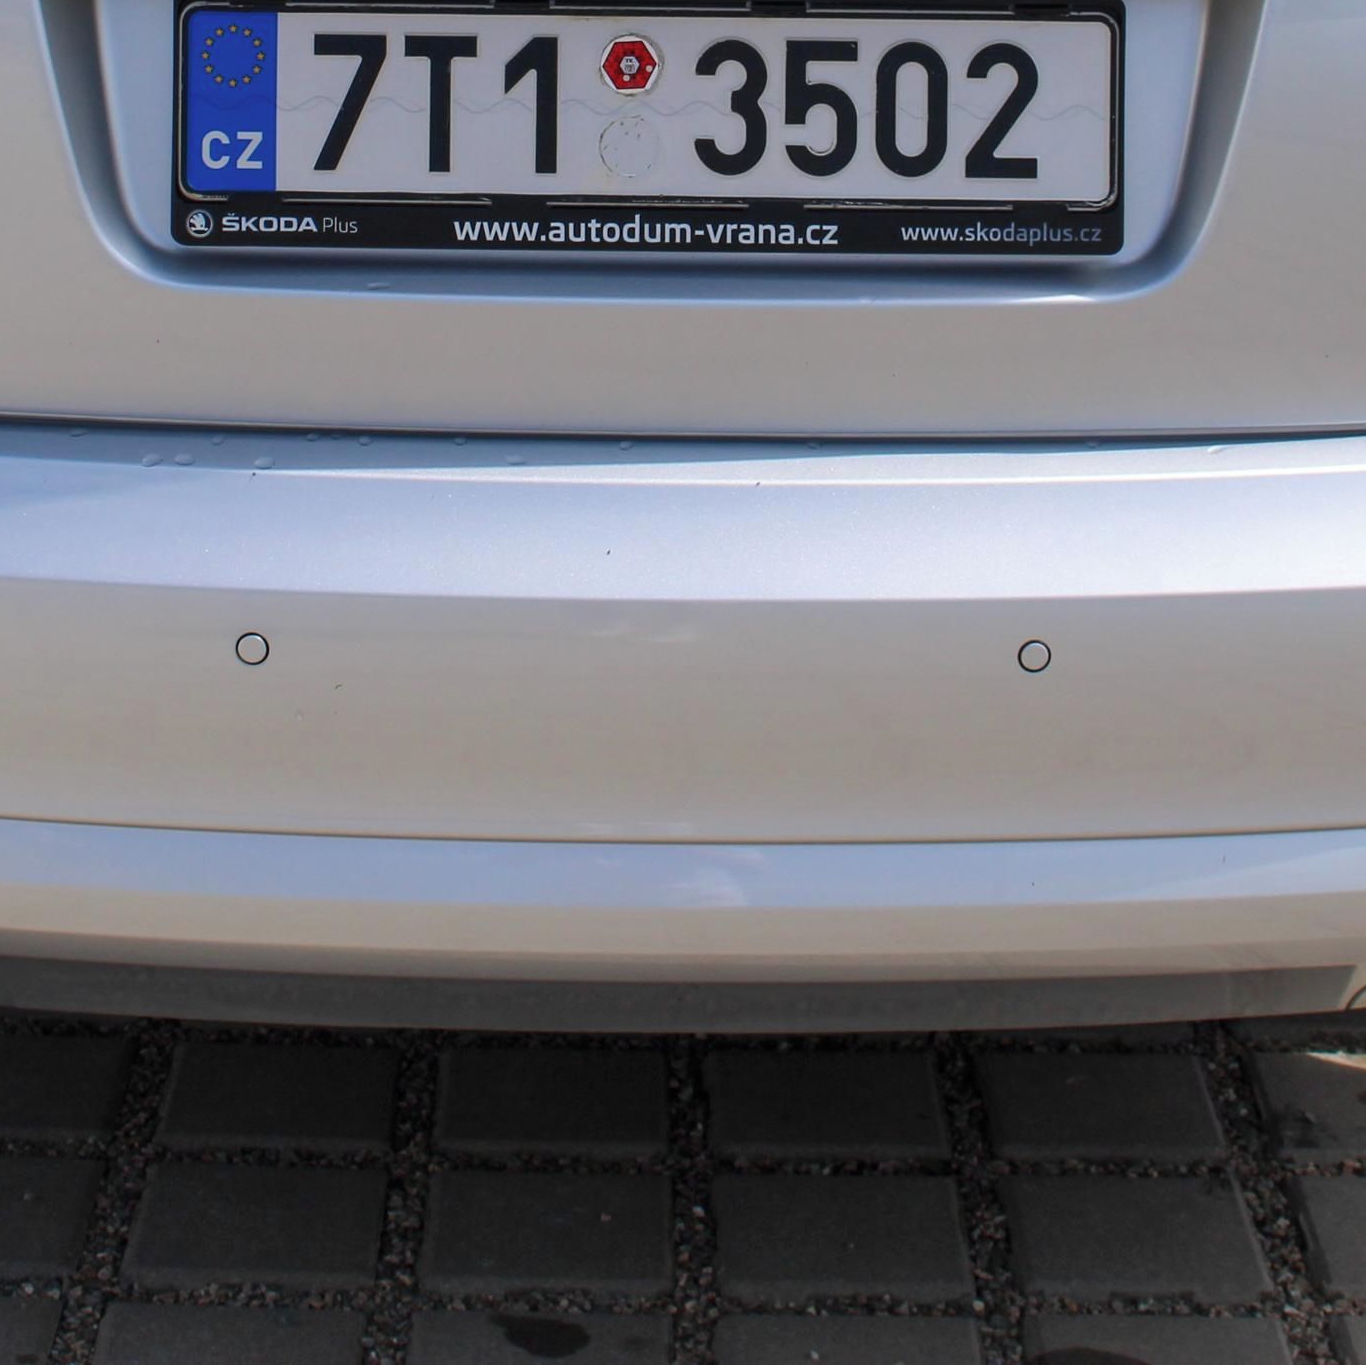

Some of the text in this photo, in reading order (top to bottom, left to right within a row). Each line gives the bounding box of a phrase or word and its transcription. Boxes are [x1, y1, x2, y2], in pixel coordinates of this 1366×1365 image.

[313, 34, 1038, 178] 7T1 3502
[201, 130, 263, 169] CZ
[221, 212, 358, 234] ŠKODA Plus
[453, 214, 839, 245] www.autodum-vrana.cz
[900, 222, 1103, 246] www.skodaplus.cz
